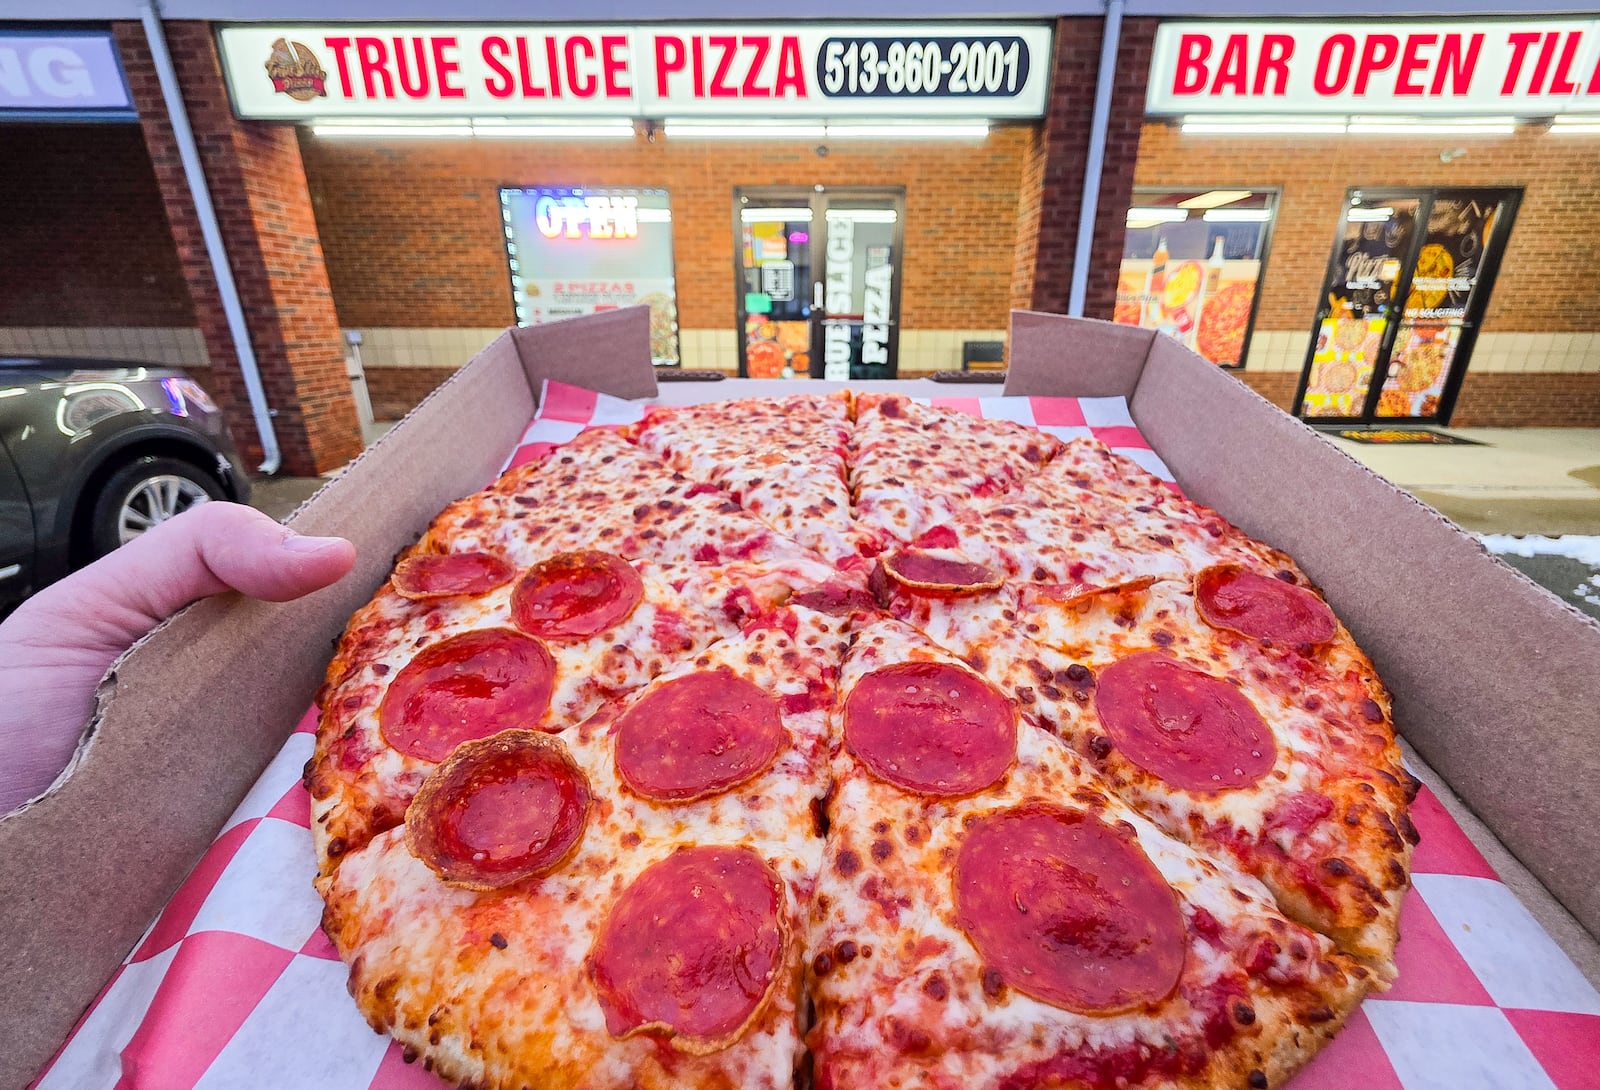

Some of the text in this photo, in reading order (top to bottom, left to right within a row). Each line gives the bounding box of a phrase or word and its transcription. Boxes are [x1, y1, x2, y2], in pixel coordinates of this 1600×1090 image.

[324, 35, 808, 99] TRUE SLICE PIZZA
[823, 41, 1021, 94] 513-860-2001
[1172, 33, 1296, 96] BAR
[1313, 33, 1486, 97] OPEN
[535, 196, 638, 239] OPEN
[826, 217, 854, 315] SLICE
[862, 264, 892, 364] PIZZA
[1405, 308, 1420, 317] NO
